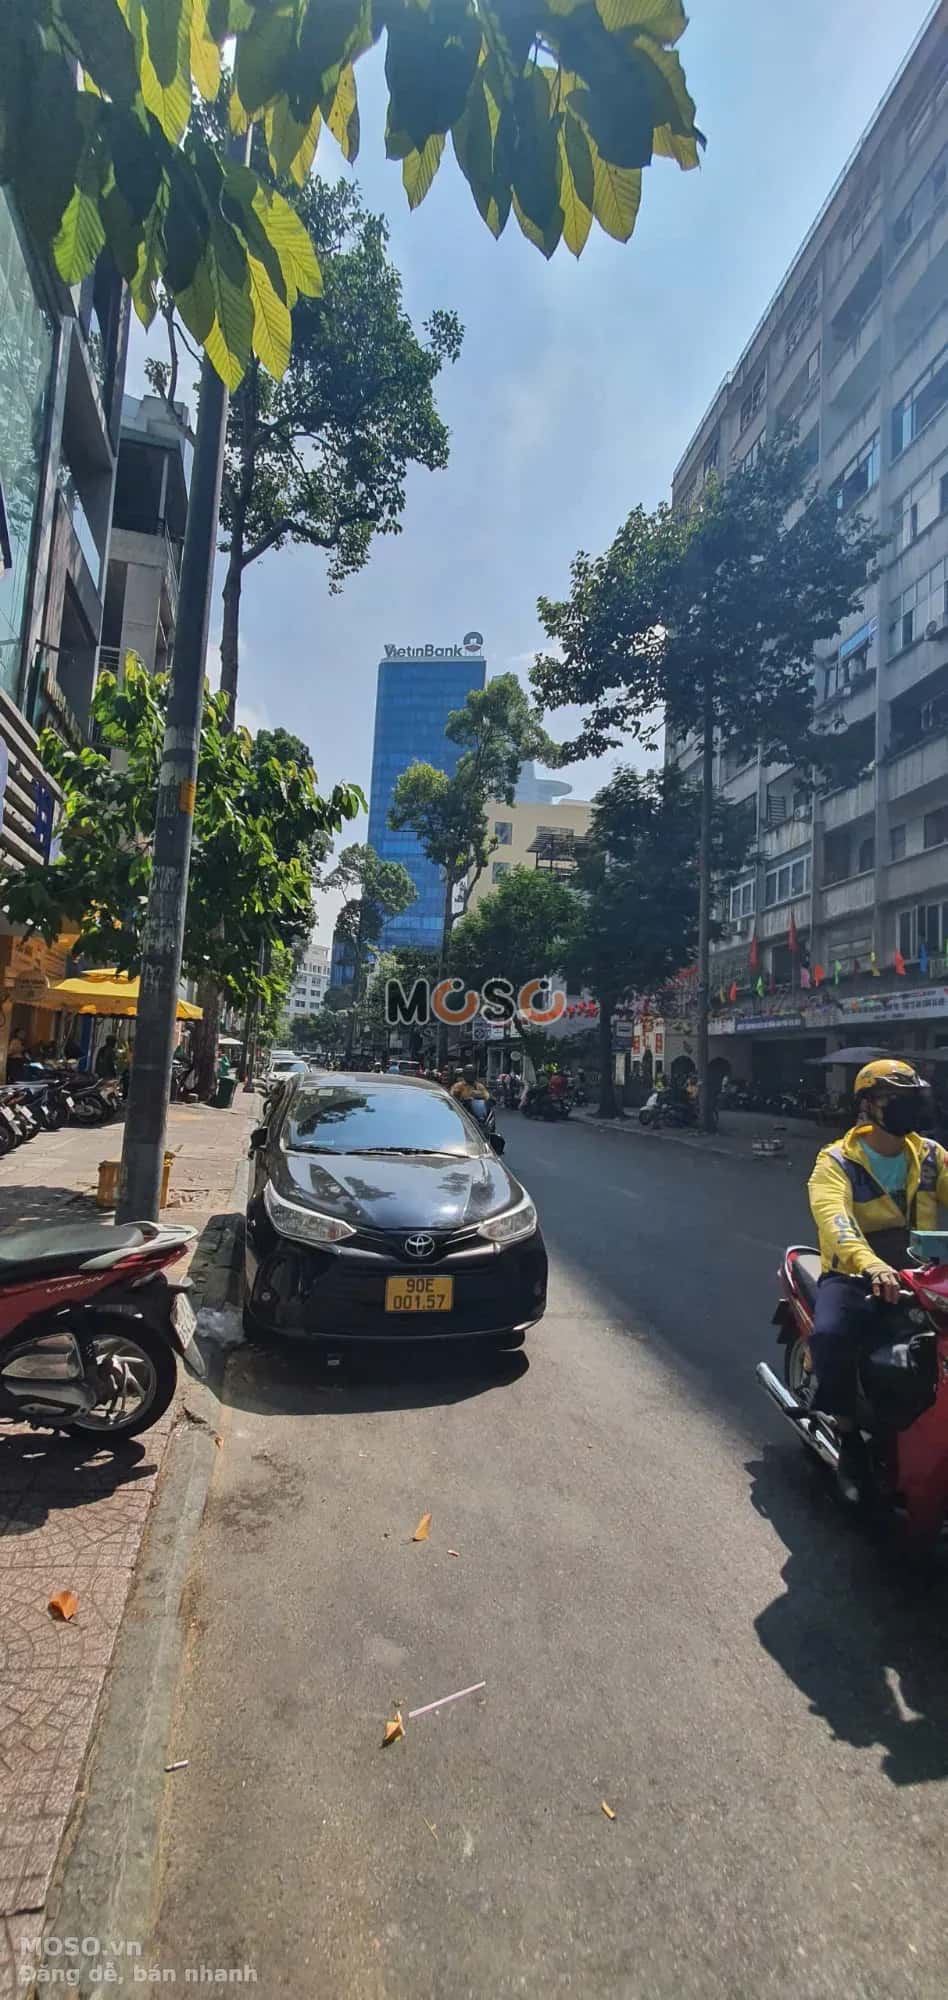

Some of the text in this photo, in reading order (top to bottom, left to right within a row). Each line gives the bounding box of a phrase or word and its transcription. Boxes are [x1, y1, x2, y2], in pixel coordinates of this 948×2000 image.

[384, 644, 463, 657] VietinBank
[406, 1278, 434, 1293] 90E
[393, 1294, 446, 1310] 001.57
